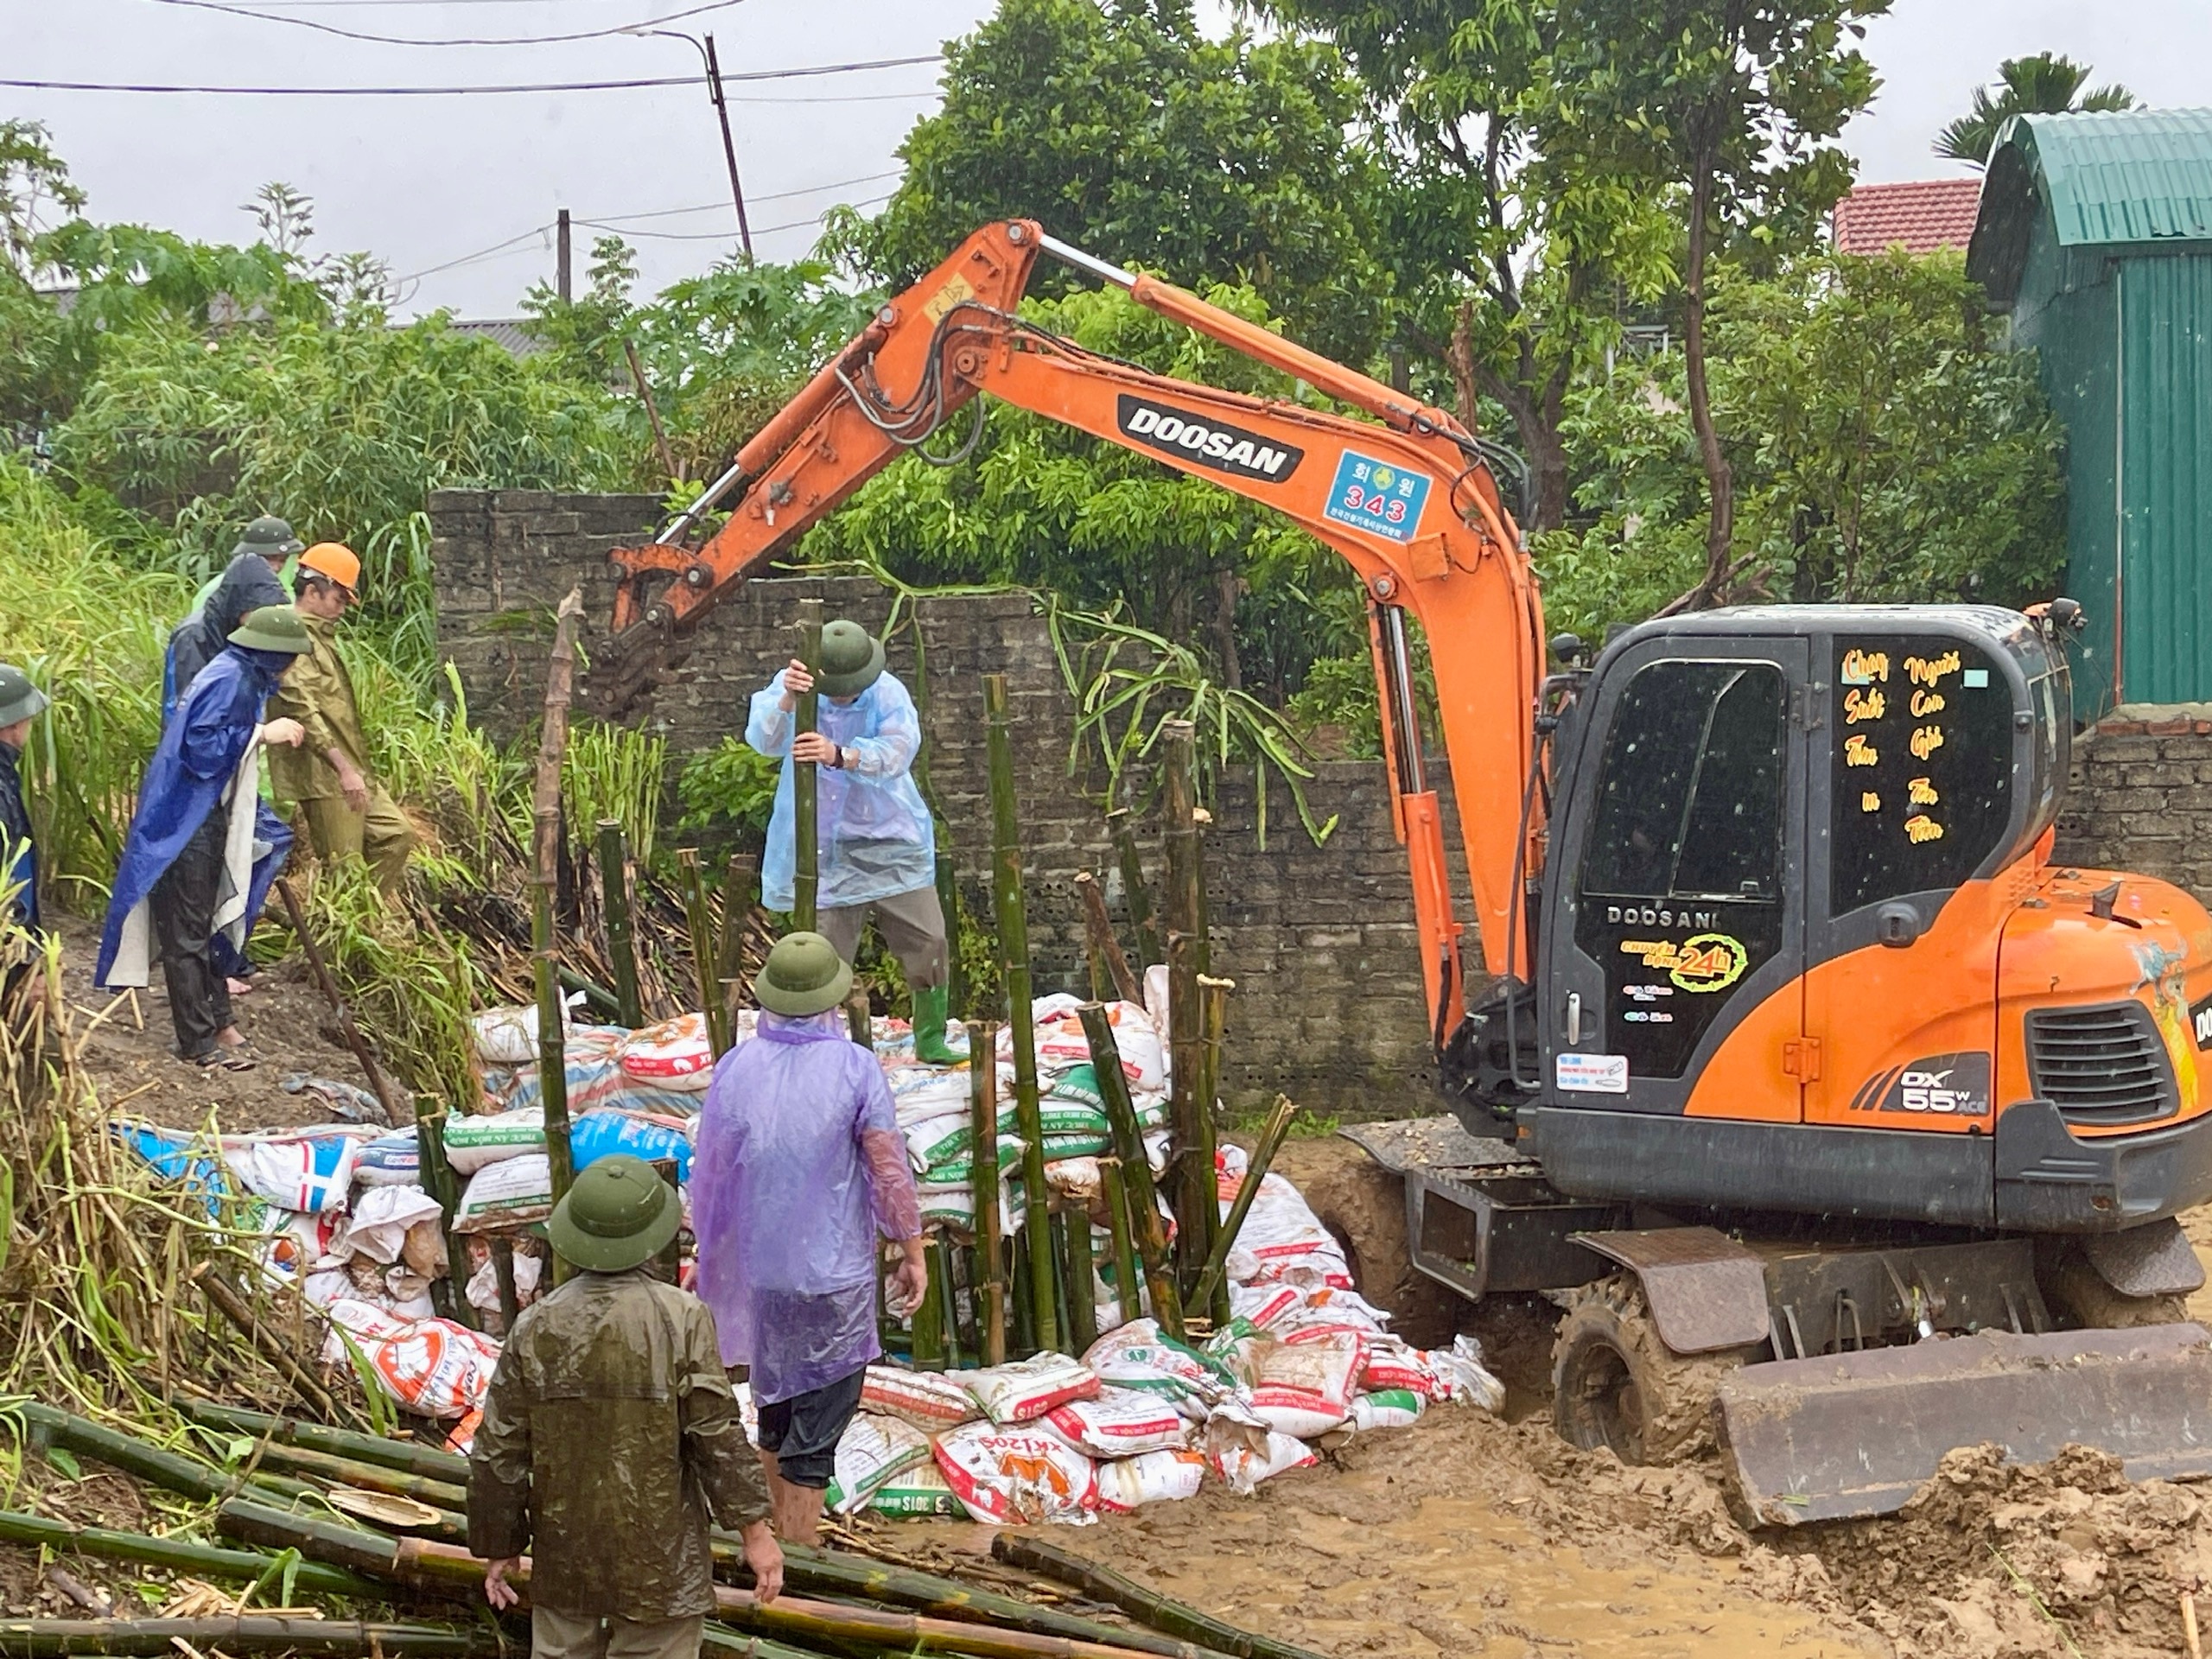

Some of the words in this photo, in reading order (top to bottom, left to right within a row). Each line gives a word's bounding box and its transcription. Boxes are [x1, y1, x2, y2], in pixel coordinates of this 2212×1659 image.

[1127, 407, 1287, 475] DOOSAN
[1352, 462, 1370, 484] 회
[1397, 477, 1416, 497] 원
[1344, 486, 1408, 524] 343
[1910, 690, 1945, 717] Con
[1676, 945, 1732, 977] 24h
[1901, 1070, 1954, 1089] DX
